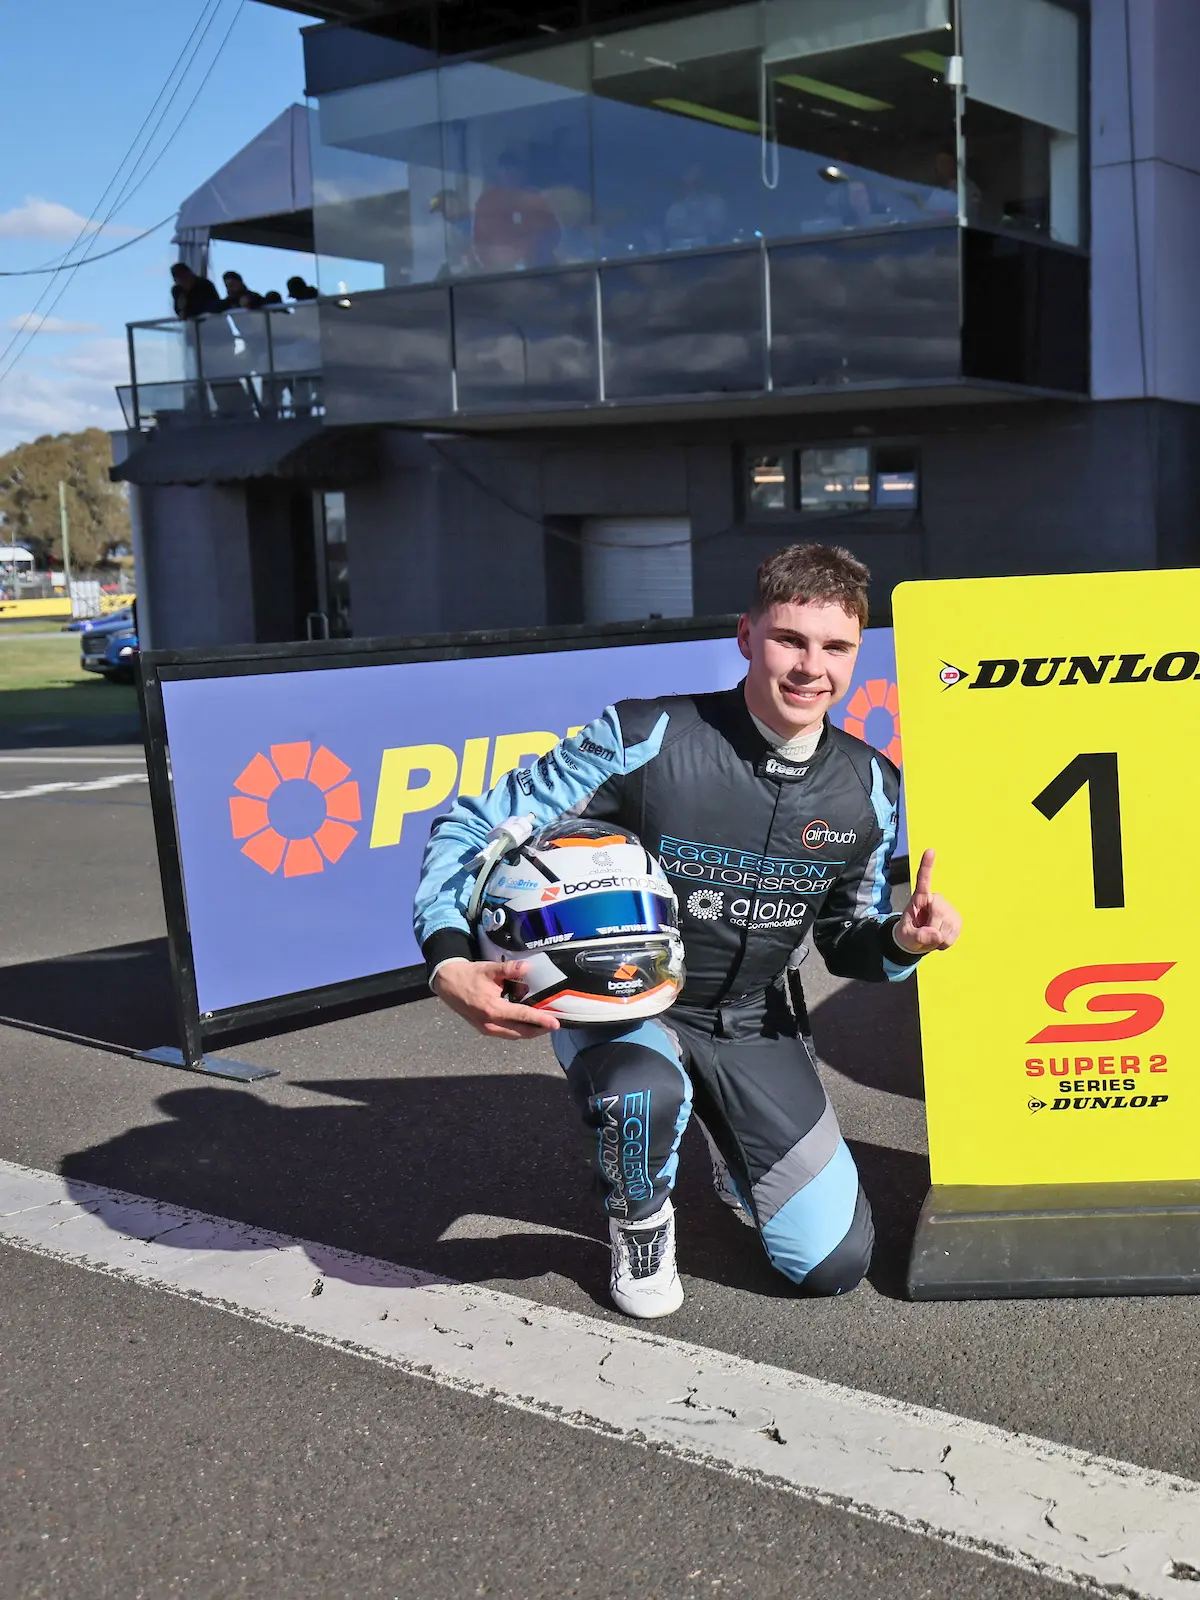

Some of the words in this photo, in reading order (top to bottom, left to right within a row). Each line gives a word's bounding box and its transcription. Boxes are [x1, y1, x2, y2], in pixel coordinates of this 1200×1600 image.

[765, 758, 810, 777] freem
[804, 825, 857, 846] airtouch
[1031, 752, 1126, 909] 1
[659, 838, 828, 879] EGGLESTON
[658, 854, 837, 893] MOTORSPORT
[729, 898, 808, 921] aloha
[606, 924, 643, 935] PILATUS
[532, 934, 566, 949] PILATUS
[607, 978, 644, 991] boost
[1025, 1055, 1141, 1077] SUPER
[1149, 1054, 1168, 1073] 2
[1059, 1078, 1136, 1093] SERIES
[1049, 1095, 1169, 1111] DUNLOP
[622, 1090, 648, 1202] EGGLESTON
